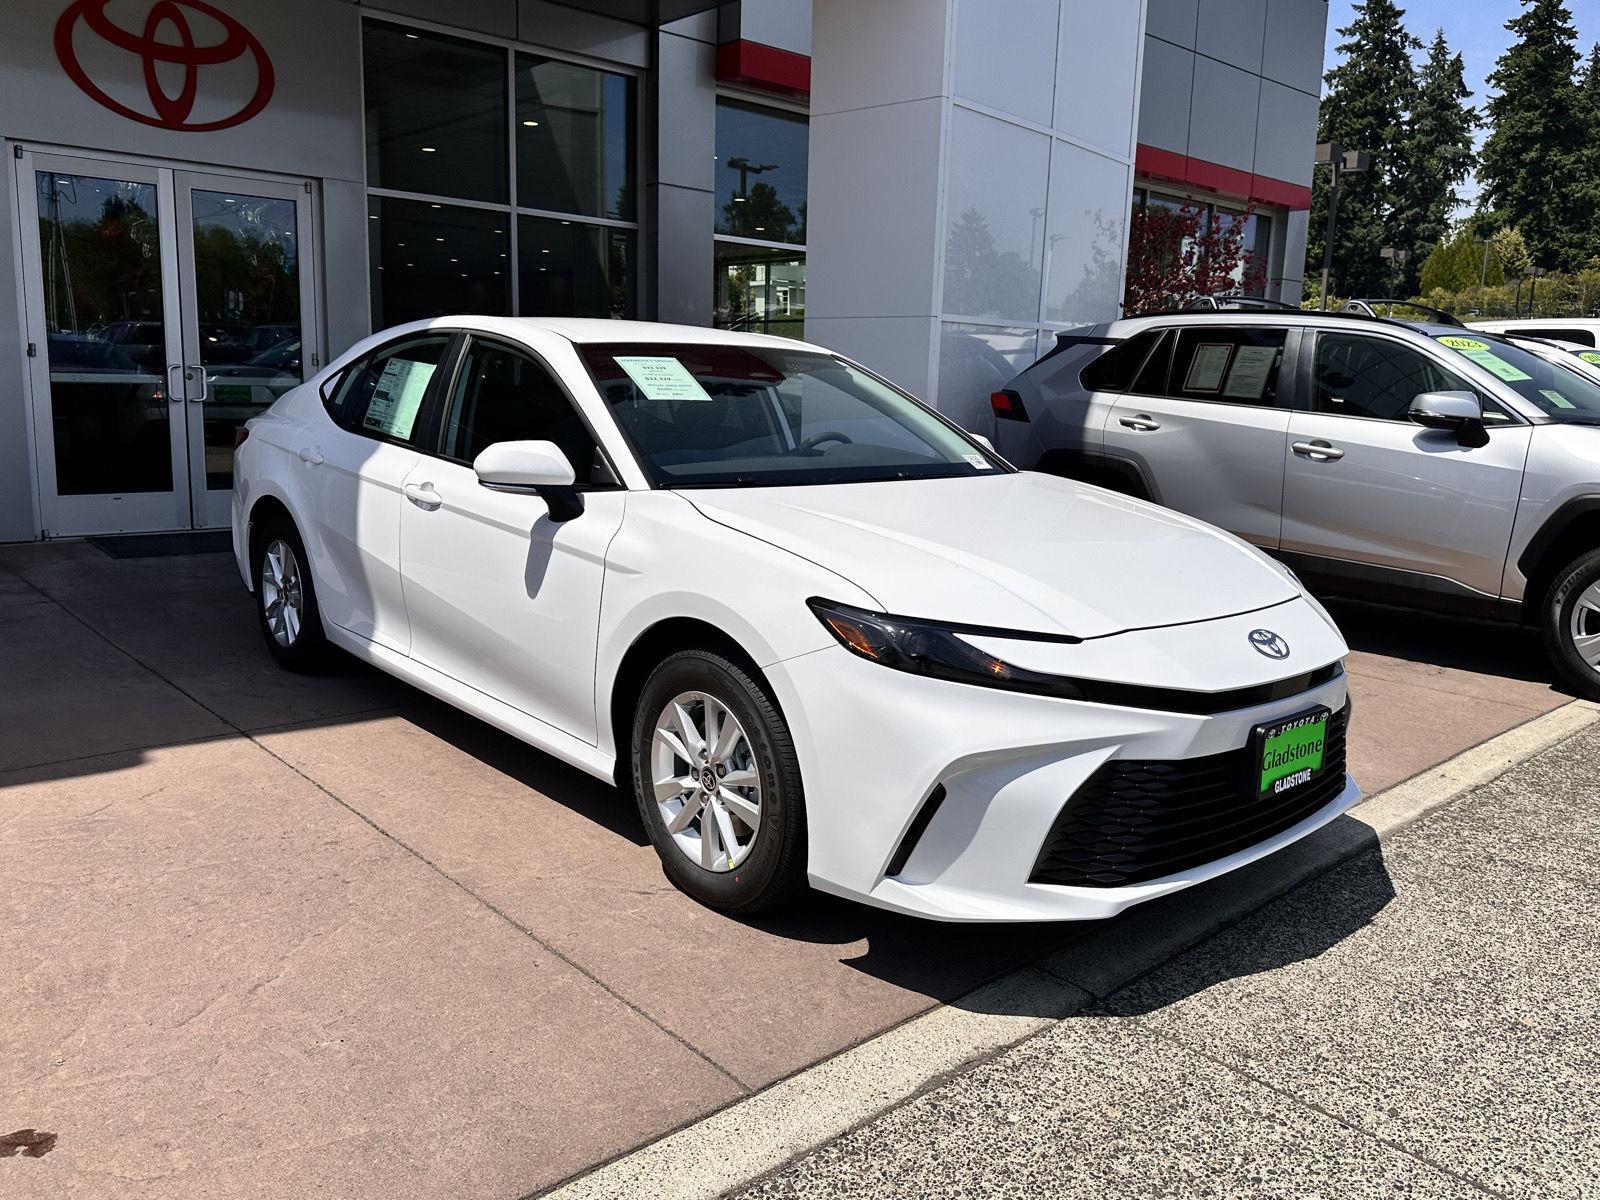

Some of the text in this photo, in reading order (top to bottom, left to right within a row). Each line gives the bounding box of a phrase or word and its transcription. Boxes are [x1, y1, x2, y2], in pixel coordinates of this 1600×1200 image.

[1445, 339, 1482, 348] 2023
[1281, 716, 1316, 732] TOYOTA
[1263, 739, 1322, 771] Gladstone
[1275, 769, 1311, 793] GLADSTONE
